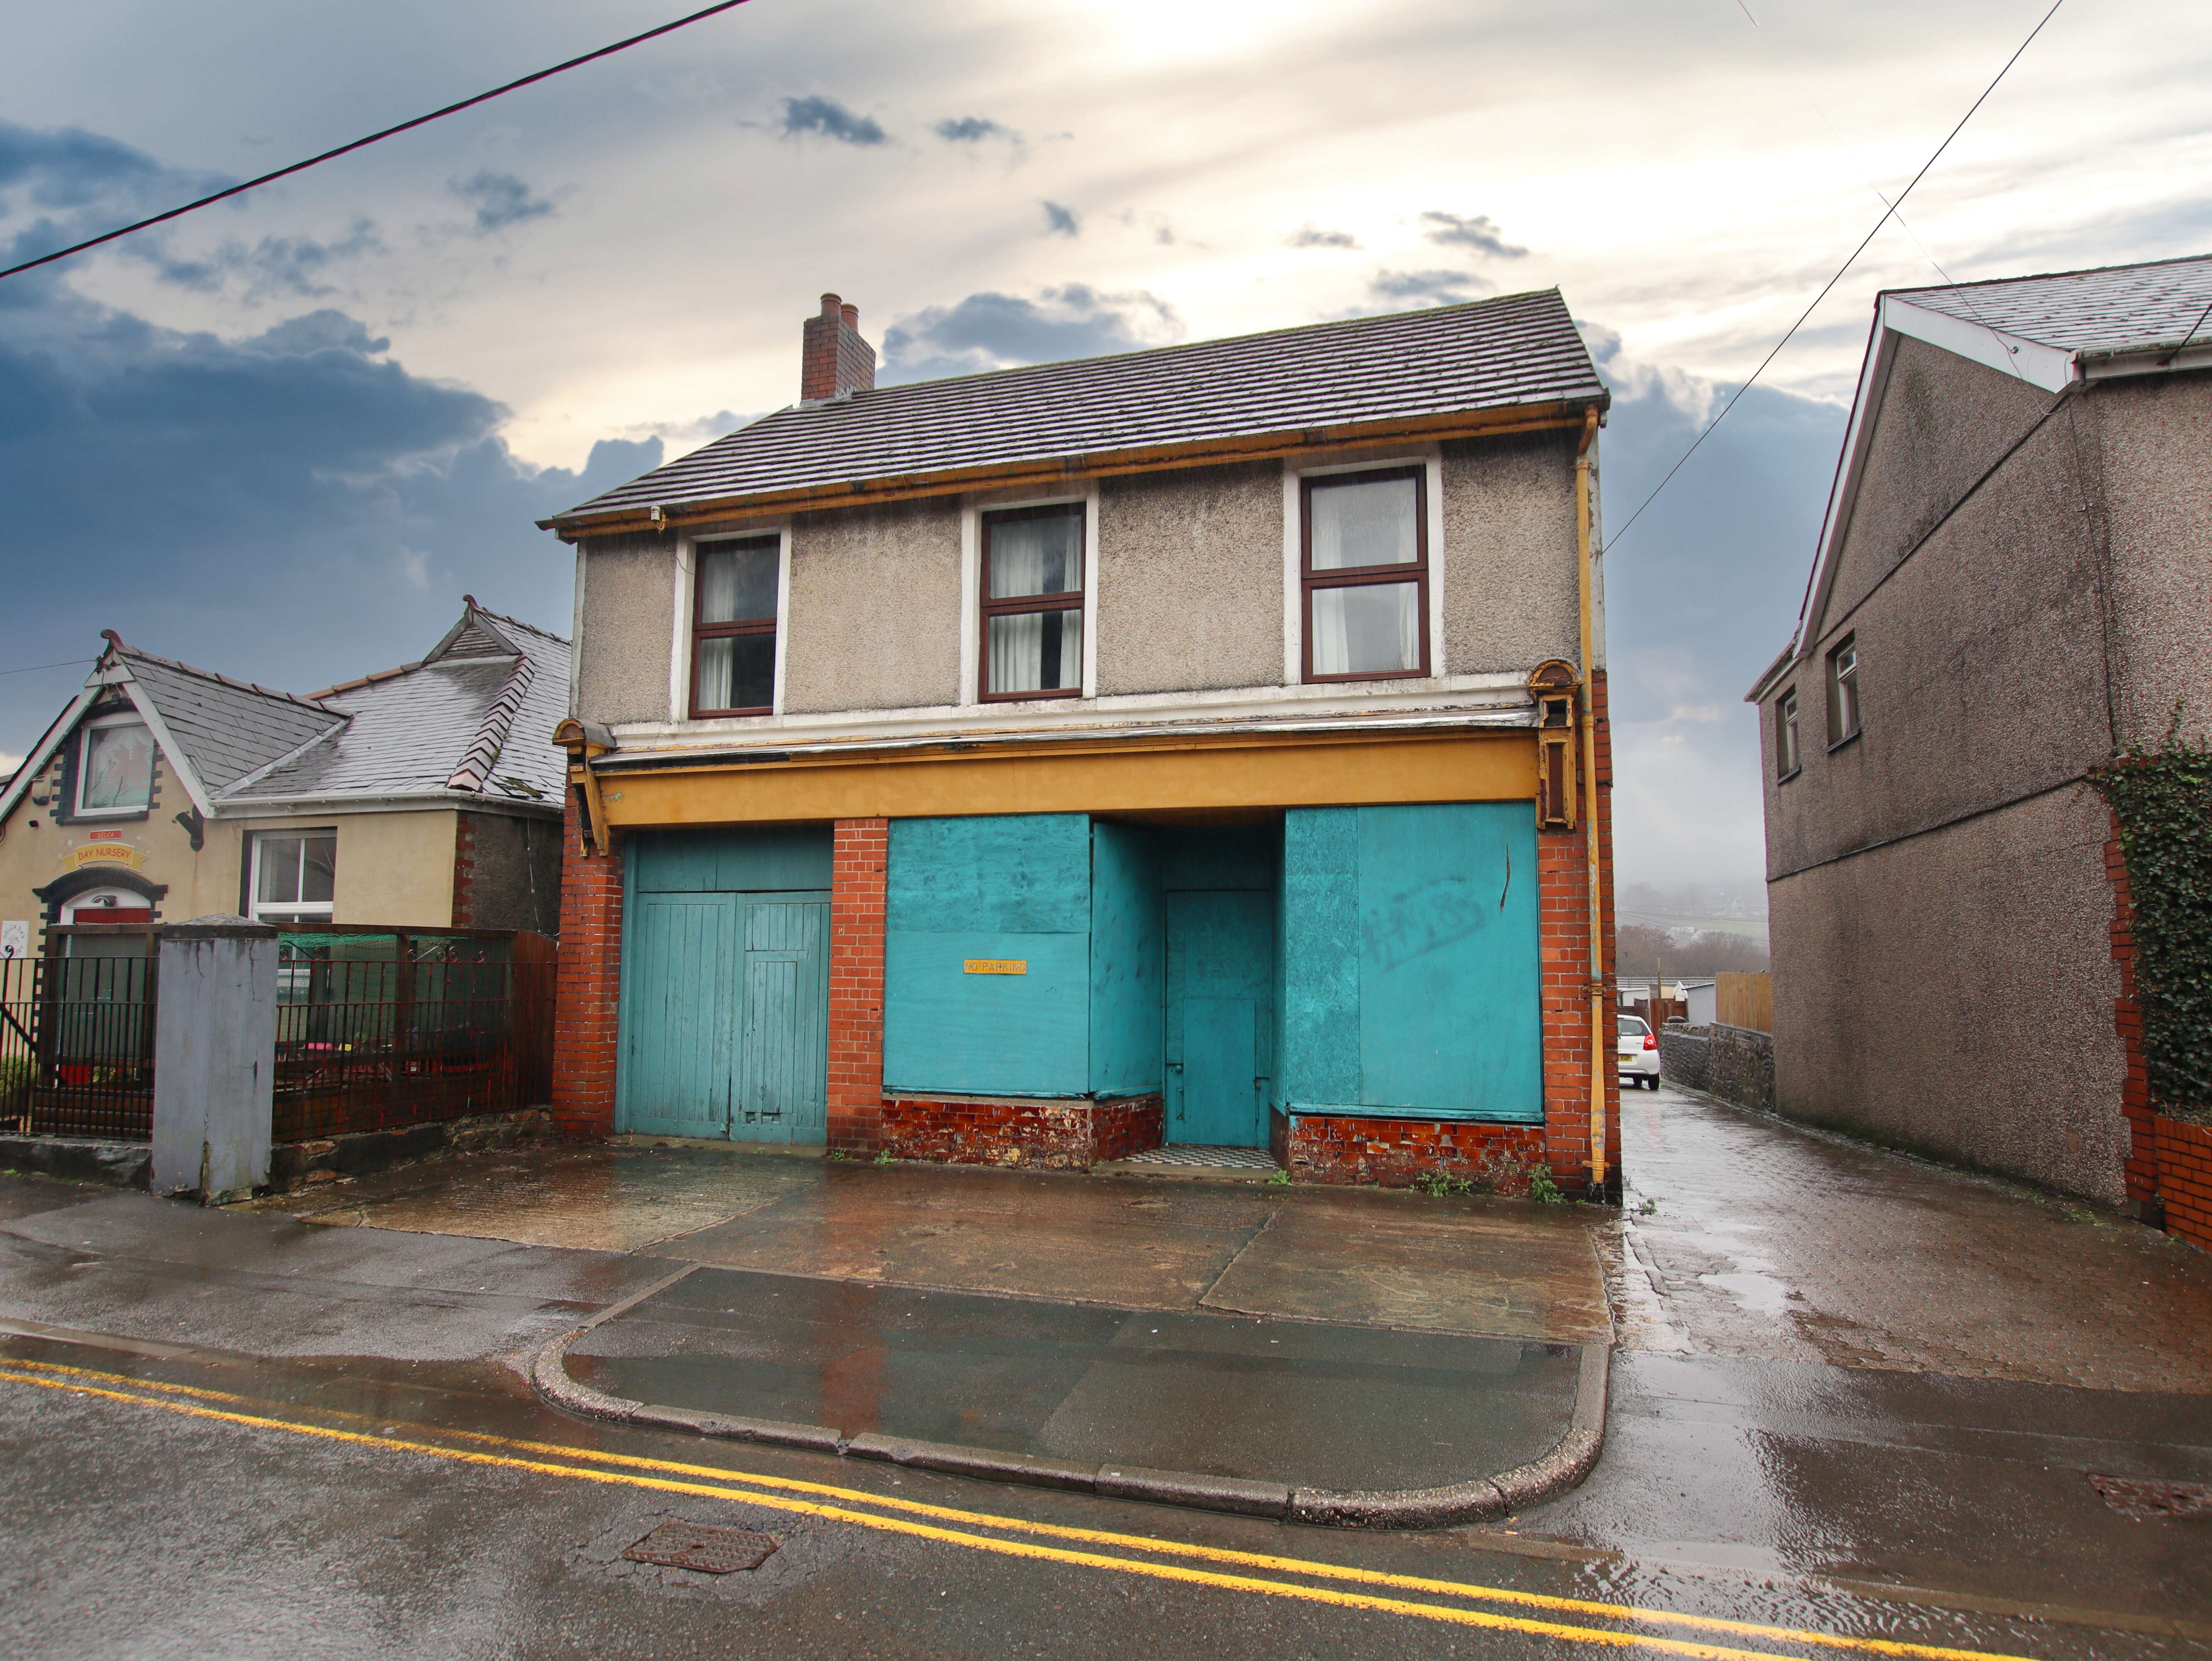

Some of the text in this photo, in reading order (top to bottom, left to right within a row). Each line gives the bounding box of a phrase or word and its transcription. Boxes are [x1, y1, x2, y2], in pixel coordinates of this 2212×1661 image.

[78, 848, 130, 860] DAY NURSERY
[965, 962, 1025, 972] NO PARKING
